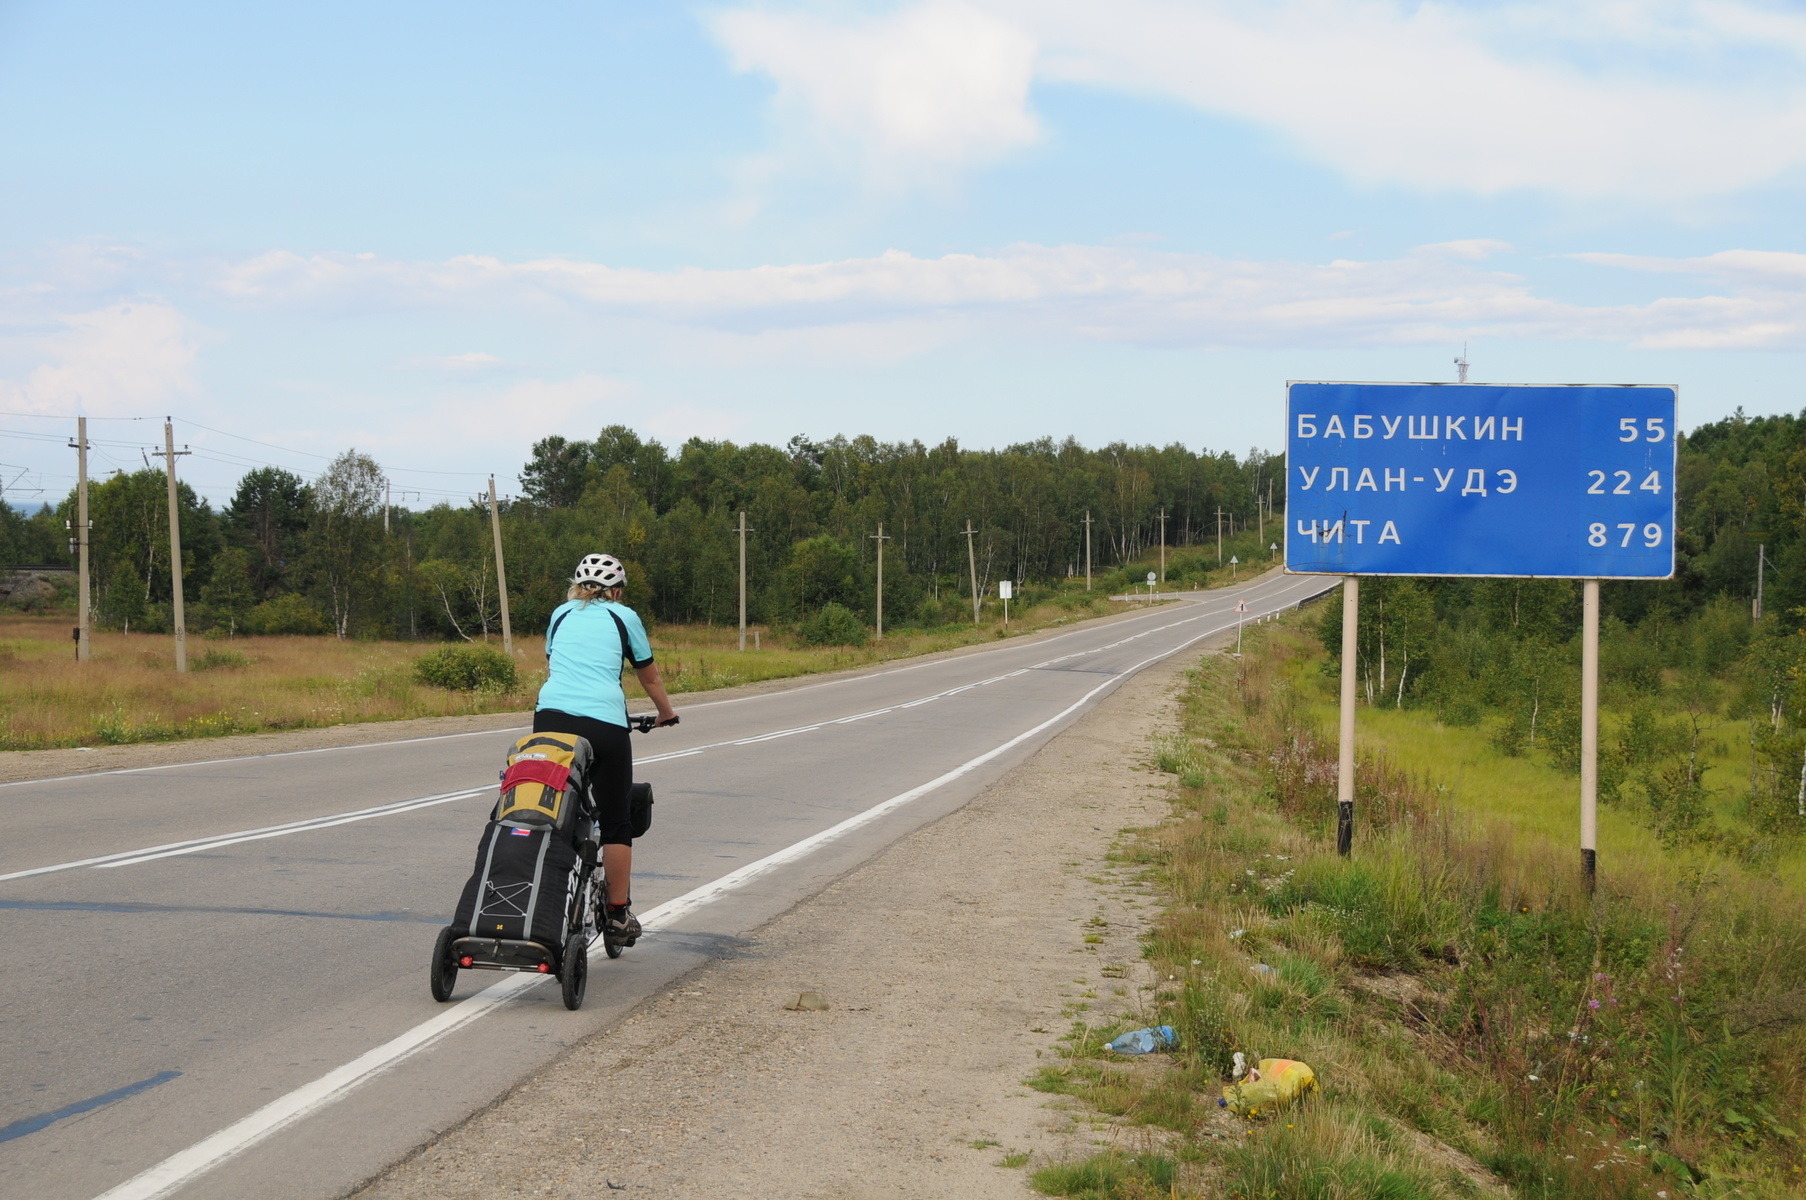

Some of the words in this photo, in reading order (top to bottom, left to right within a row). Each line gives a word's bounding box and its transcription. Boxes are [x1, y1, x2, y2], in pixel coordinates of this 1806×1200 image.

[1297, 413, 1523, 441] БАБУШКИН
[1619, 417, 1666, 443] 55
[1299, 466, 1518, 497] УЛАН-УДЭ
[1587, 469, 1662, 495] 224
[1297, 519, 1401, 545] ЧИТА
[1587, 522, 1663, 548] 879
